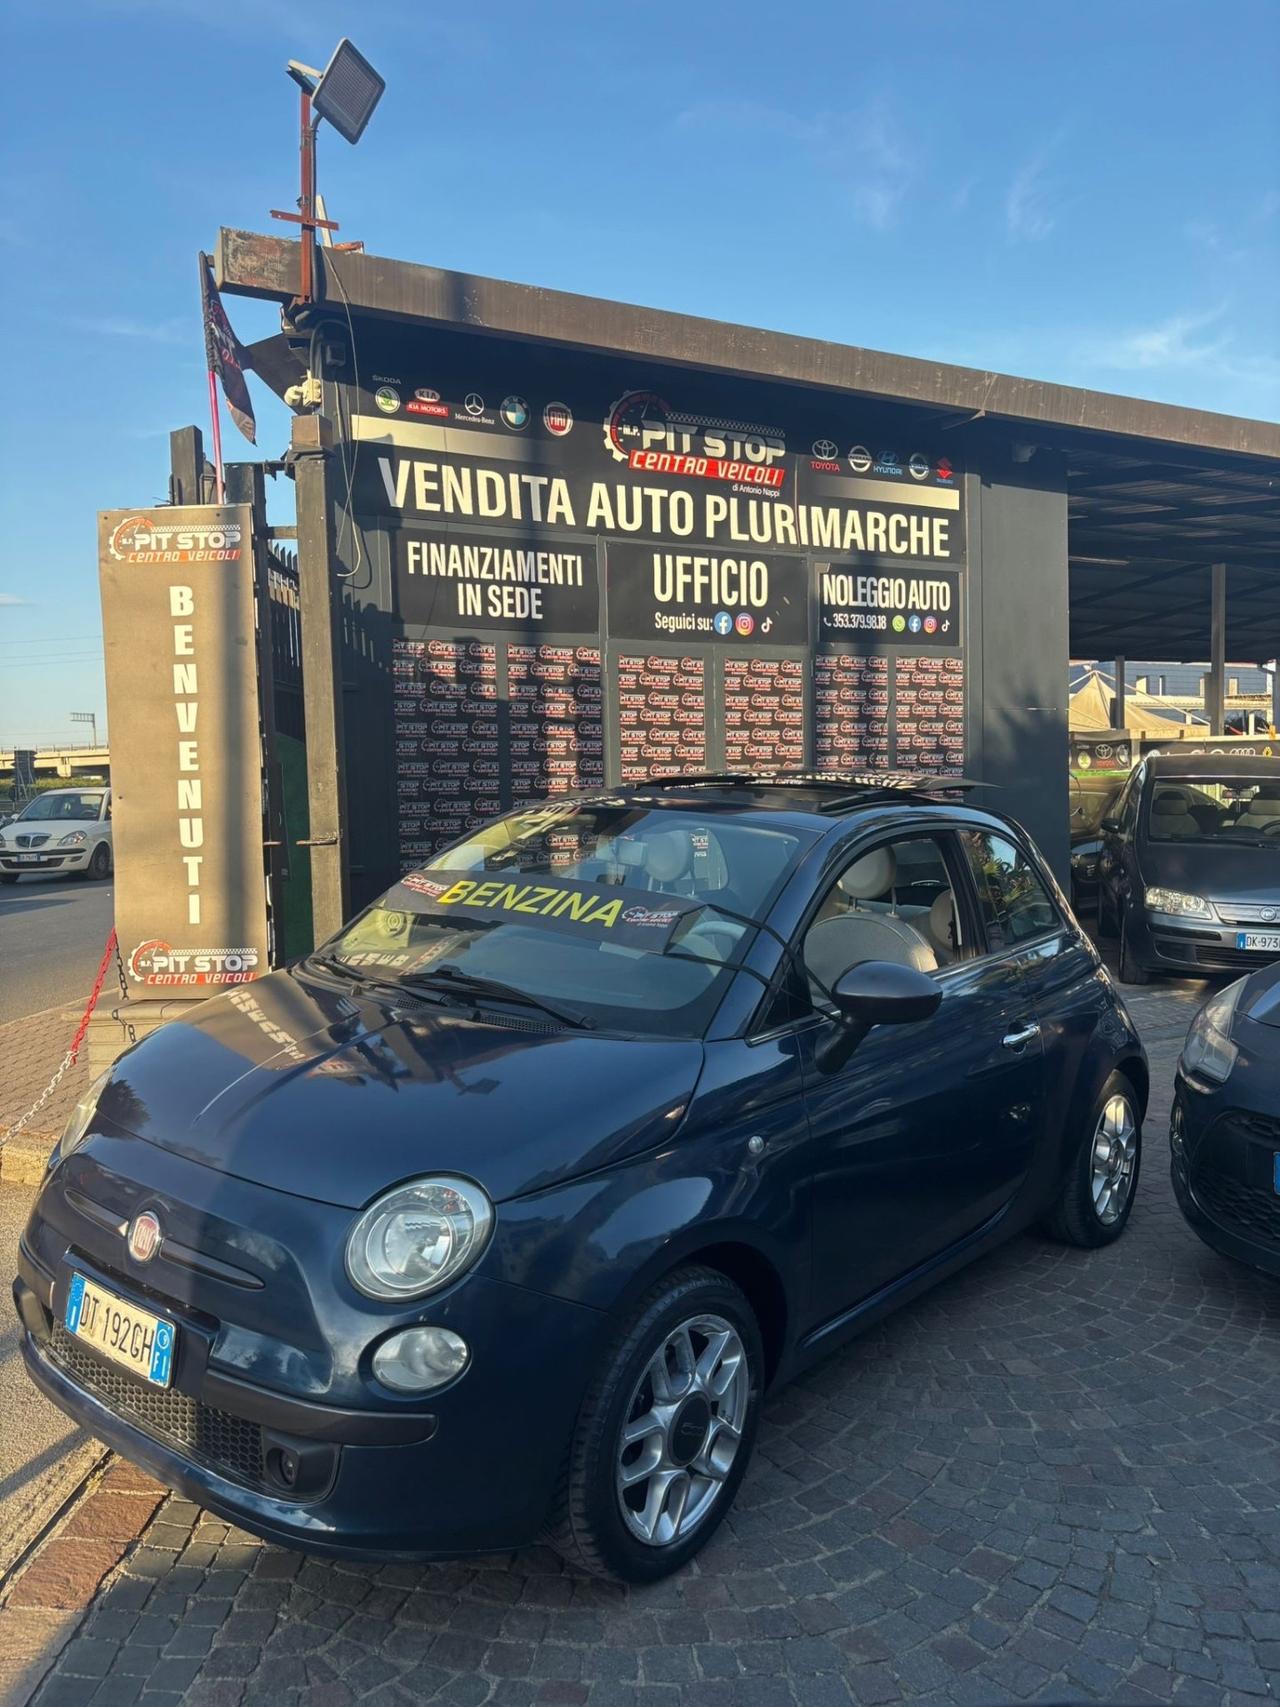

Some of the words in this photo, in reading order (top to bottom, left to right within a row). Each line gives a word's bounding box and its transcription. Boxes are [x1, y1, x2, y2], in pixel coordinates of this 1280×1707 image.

[421, 405, 446, 413] MOTORS
[455, 413, 495, 424] Mercedes-Benz
[642, 420, 698, 454] PIT
[703, 428, 786, 465] STOP
[810, 461, 840, 472] TOYOTA
[873, 465, 903, 475] HYUNDAI
[740, 484, 762, 495] Antonio
[763, 488, 780, 498] Nappi
[378, 457, 576, 526] VENDITA
[586, 482, 693, 537] AUTO
[705, 494, 951, 558] PLURIMARCHE
[134, 533, 173, 551] PIT
[176, 531, 241, 550] STOP
[407, 541, 583, 586] FINANZIAMENTI
[653, 553, 768, 608] UFFICIO
[823, 574, 906, 609] NOLEGGIO
[908, 580, 951, 611] AUTO
[457, 583, 482, 616] IN
[487, 585, 543, 620] SEDE
[654, 611, 696, 633] Seguici
[697, 616, 714, 631] su:
[436, 880, 624, 928] BENZINA
[152, 956, 191, 973] PIT
[194, 955, 258, 972] STOP
[80, 1293, 100, 1331] DT
[103, 1306, 156, 1366] 192GH
